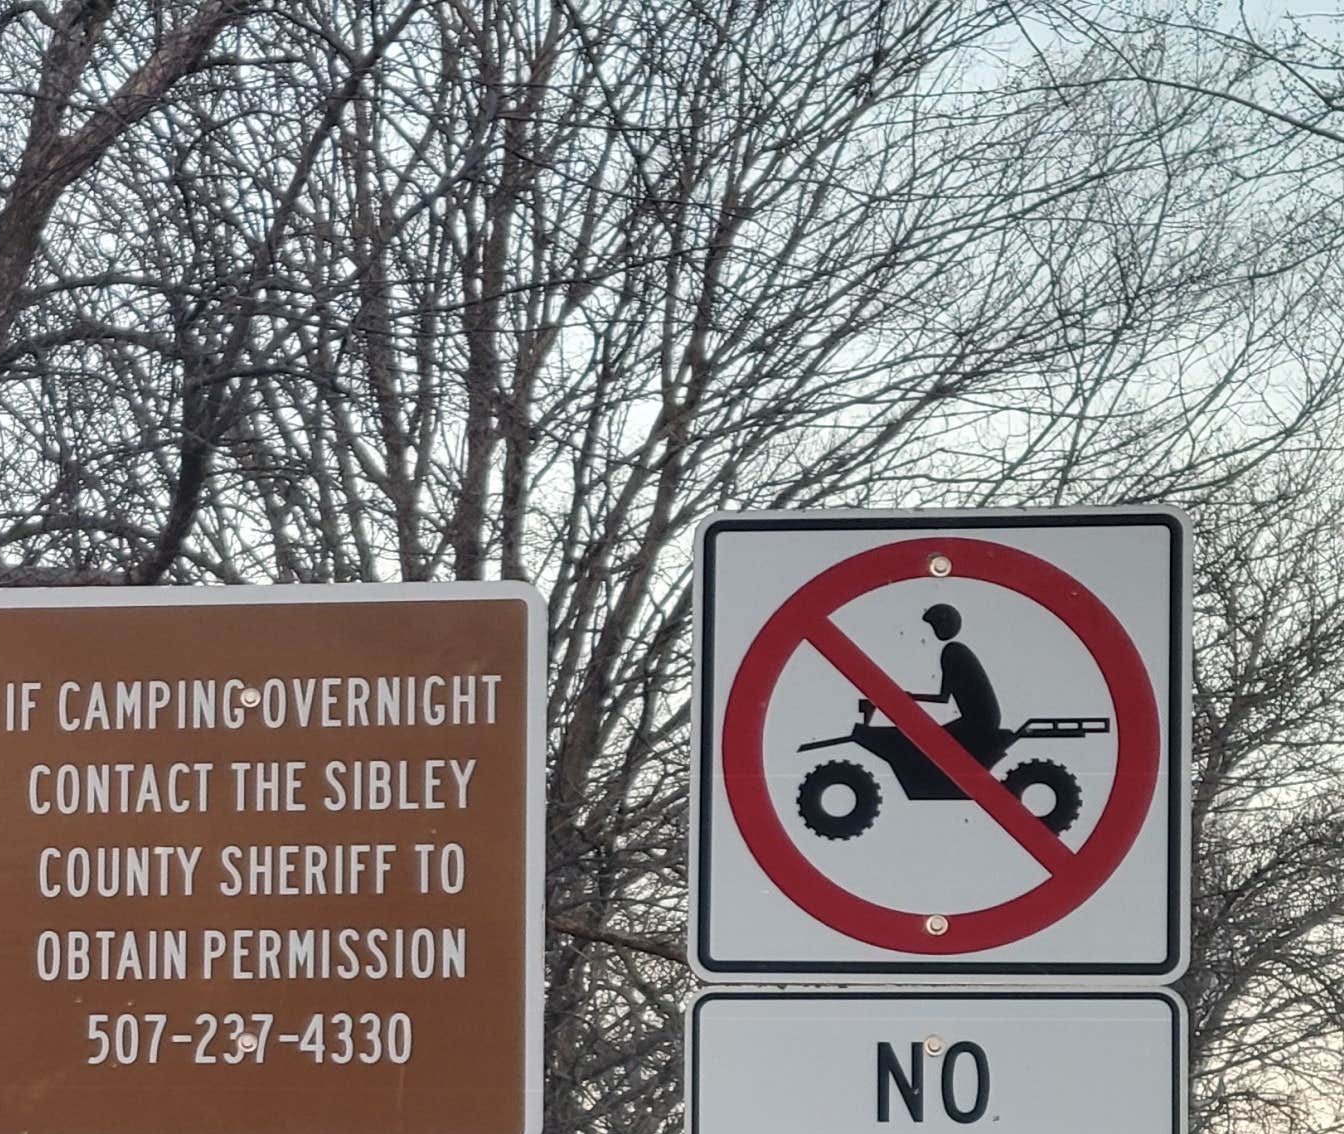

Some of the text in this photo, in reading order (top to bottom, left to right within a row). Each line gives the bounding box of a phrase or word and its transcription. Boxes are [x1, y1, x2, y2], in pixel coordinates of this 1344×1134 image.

[6, 675, 501, 732] IF CAMPING OVERNIGHT
[28, 759, 476, 815] CONTACT THE SIBLEY
[39, 843, 465, 898] COUNTY SHERIFF TO
[36, 928, 466, 981] OBTAIN PERMISSION
[87, 1012, 411, 1065] 507-237-4330
[877, 1041, 990, 1124] NO
